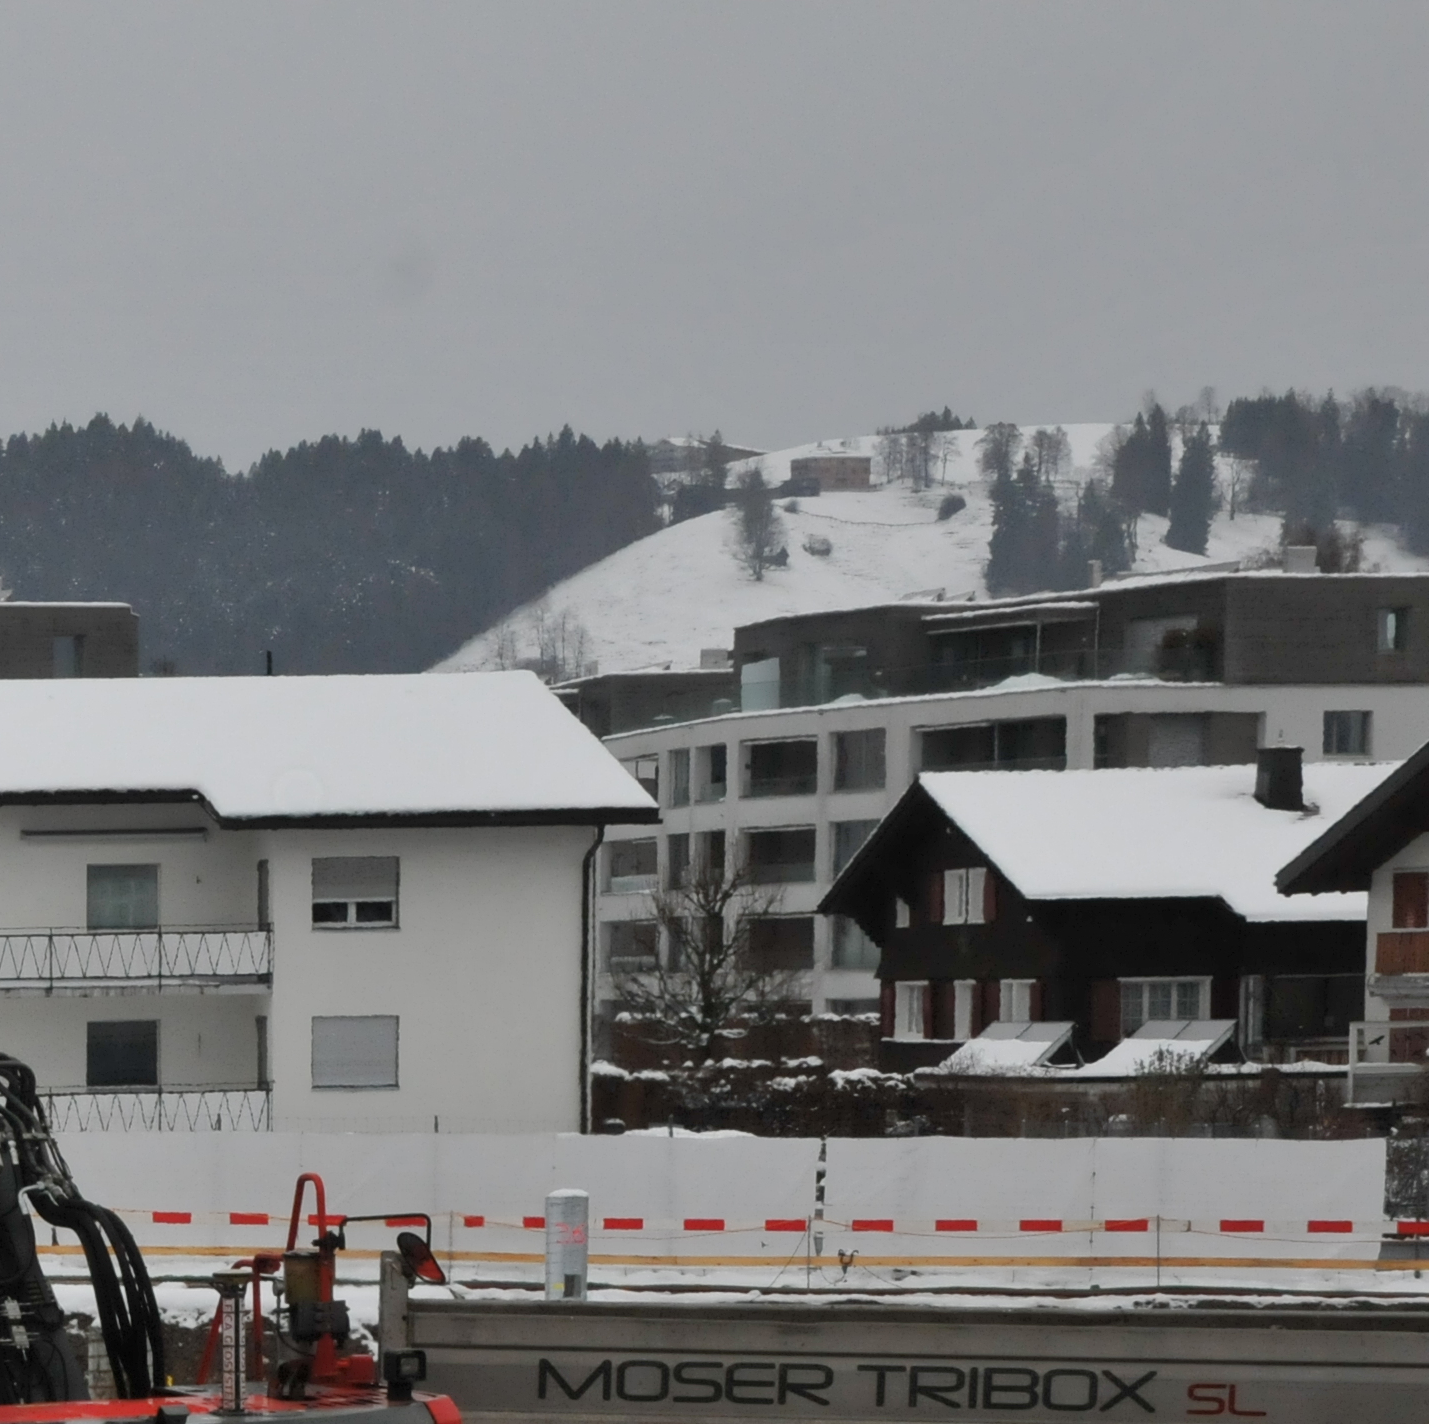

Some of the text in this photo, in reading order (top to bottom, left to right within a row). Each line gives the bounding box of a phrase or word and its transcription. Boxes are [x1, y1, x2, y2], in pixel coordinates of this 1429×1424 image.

[539, 1359, 1267, 1417] MOSER TRIBOX SL
